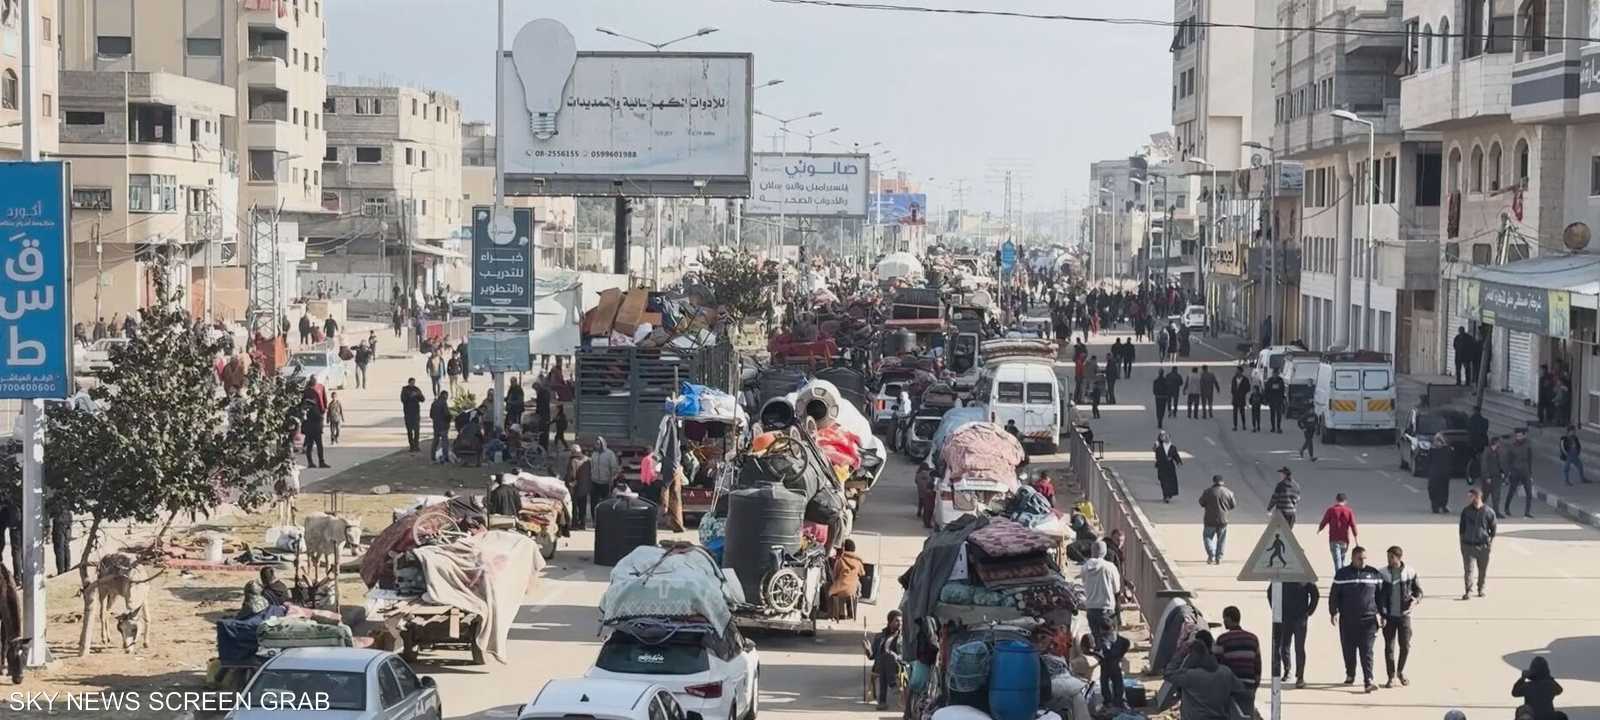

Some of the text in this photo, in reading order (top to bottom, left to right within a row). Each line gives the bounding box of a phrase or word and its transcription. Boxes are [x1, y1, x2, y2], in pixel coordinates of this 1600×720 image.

[690, 96, 726, 110] للأدوات
[785, 160, 858, 177] صالوني
[481, 251, 524, 264] خبراء
[479, 267, 524, 280] للتدريب
[480, 283, 524, 296] والتطوير
